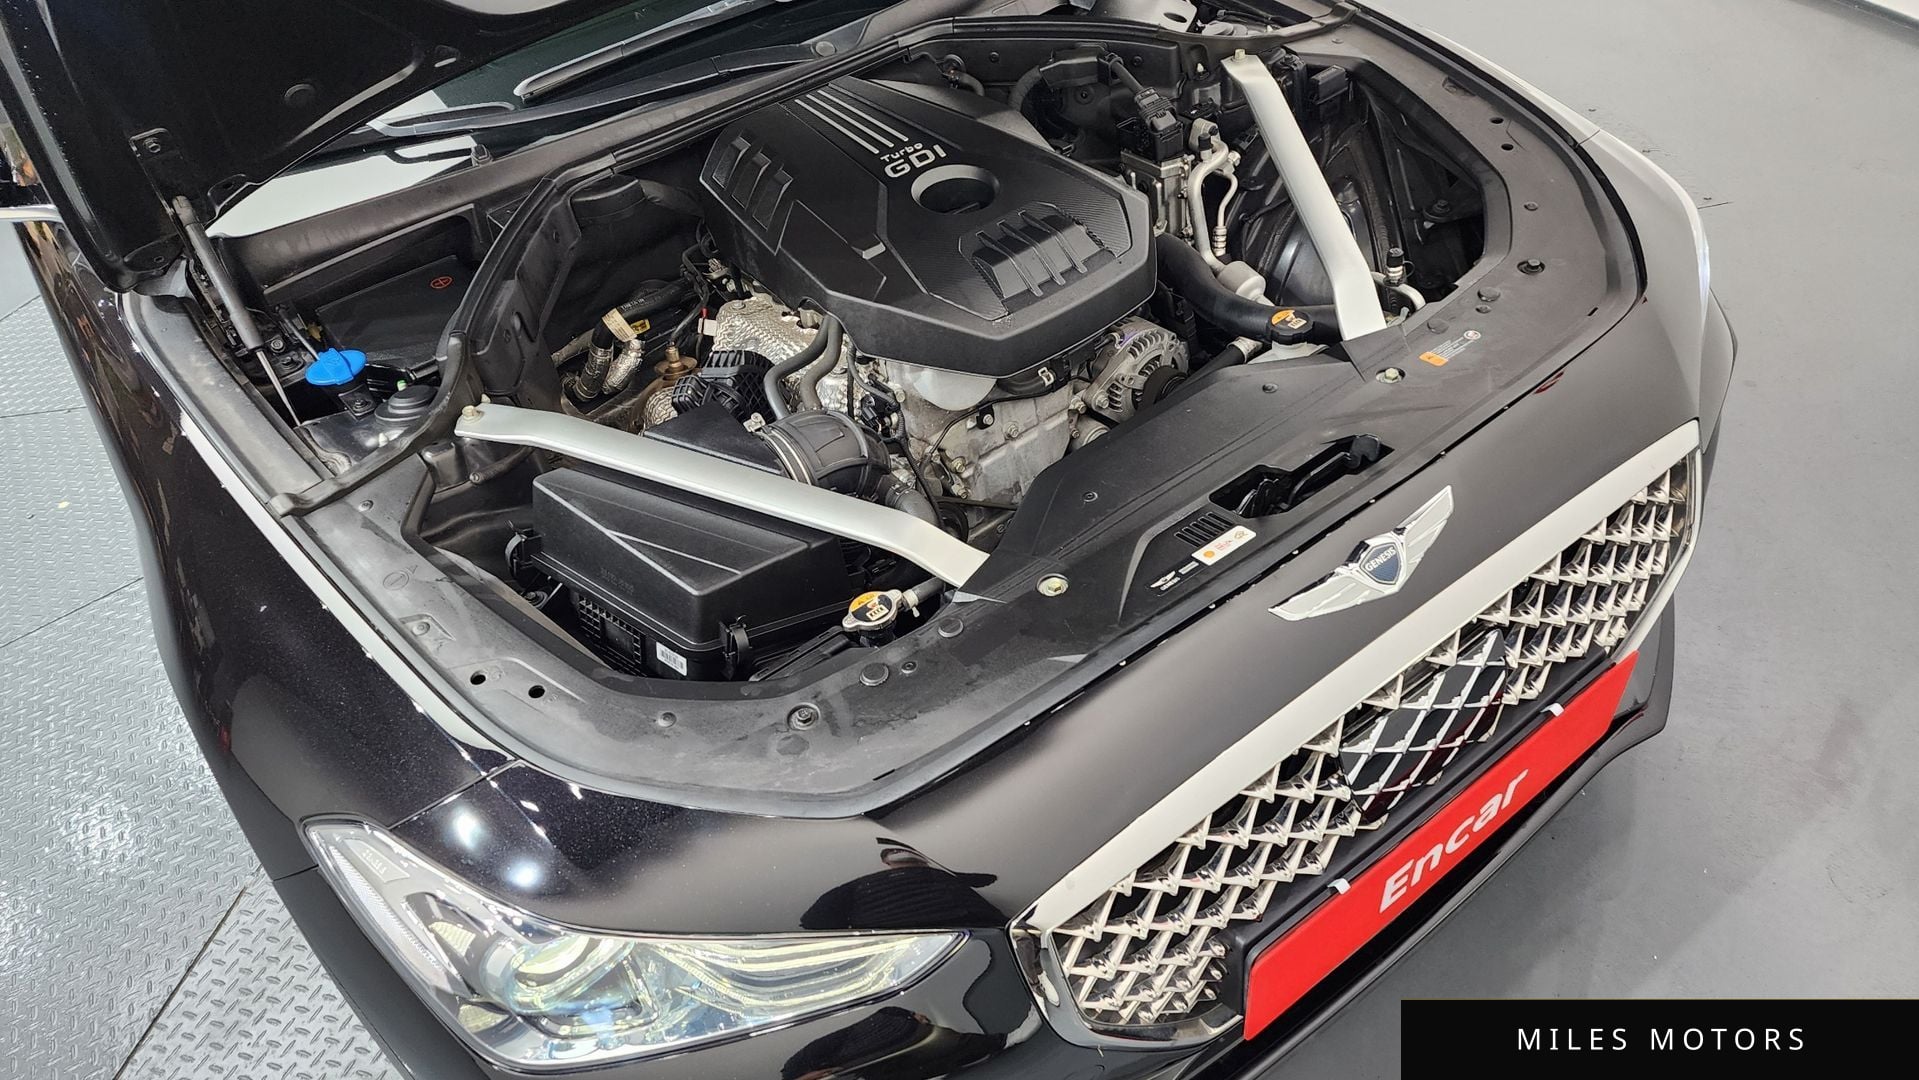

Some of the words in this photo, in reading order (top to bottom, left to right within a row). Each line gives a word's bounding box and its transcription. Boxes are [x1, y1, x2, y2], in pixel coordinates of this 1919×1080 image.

[880, 143, 923, 162] Turbo
[884, 144, 947, 178] GDI
[1364, 546, 1397, 572] GENESIS
[1379, 768, 1529, 914] Encar
